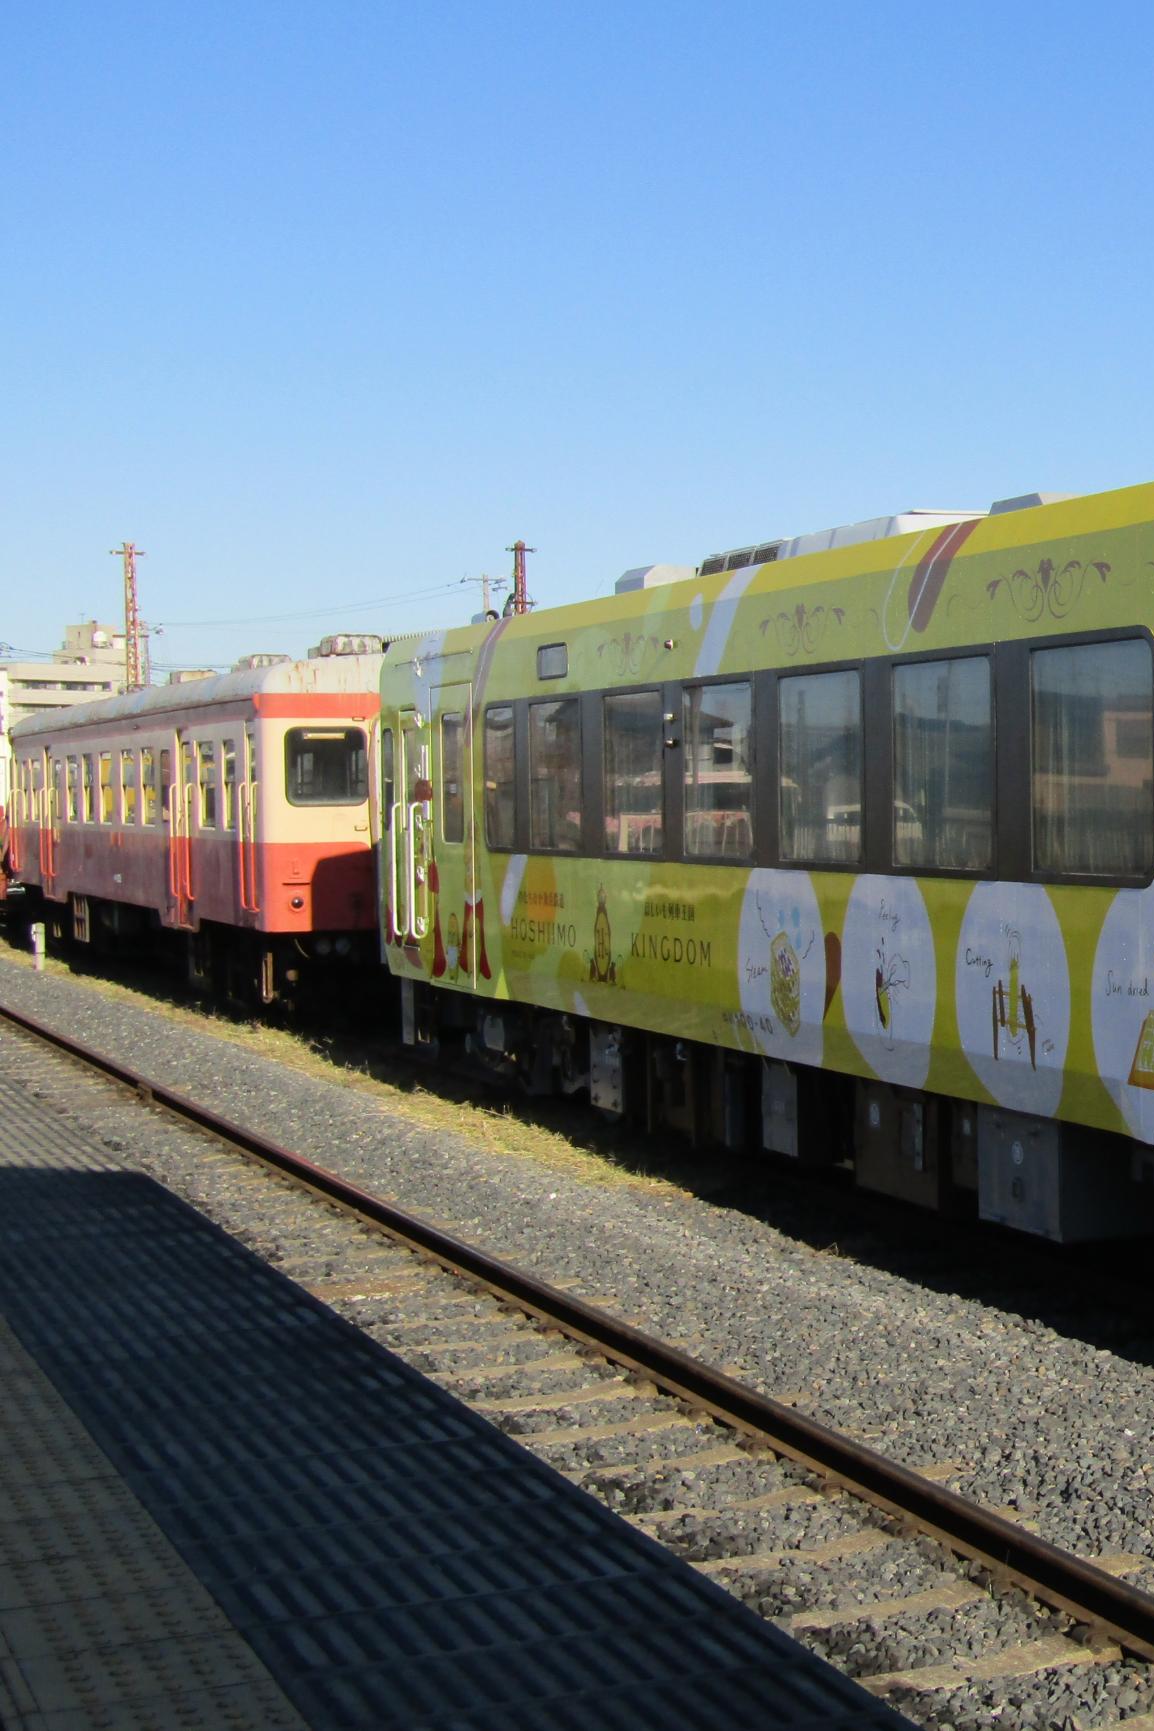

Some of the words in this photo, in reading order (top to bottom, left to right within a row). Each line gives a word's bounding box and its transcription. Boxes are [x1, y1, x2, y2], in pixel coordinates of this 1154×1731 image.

[511, 917, 577, 949] HOSHIIMO
[630, 932, 712, 968] KINGDOM
[1105, 969, 1122, 997] Sun
[1126, 976, 1150, 997] dried
